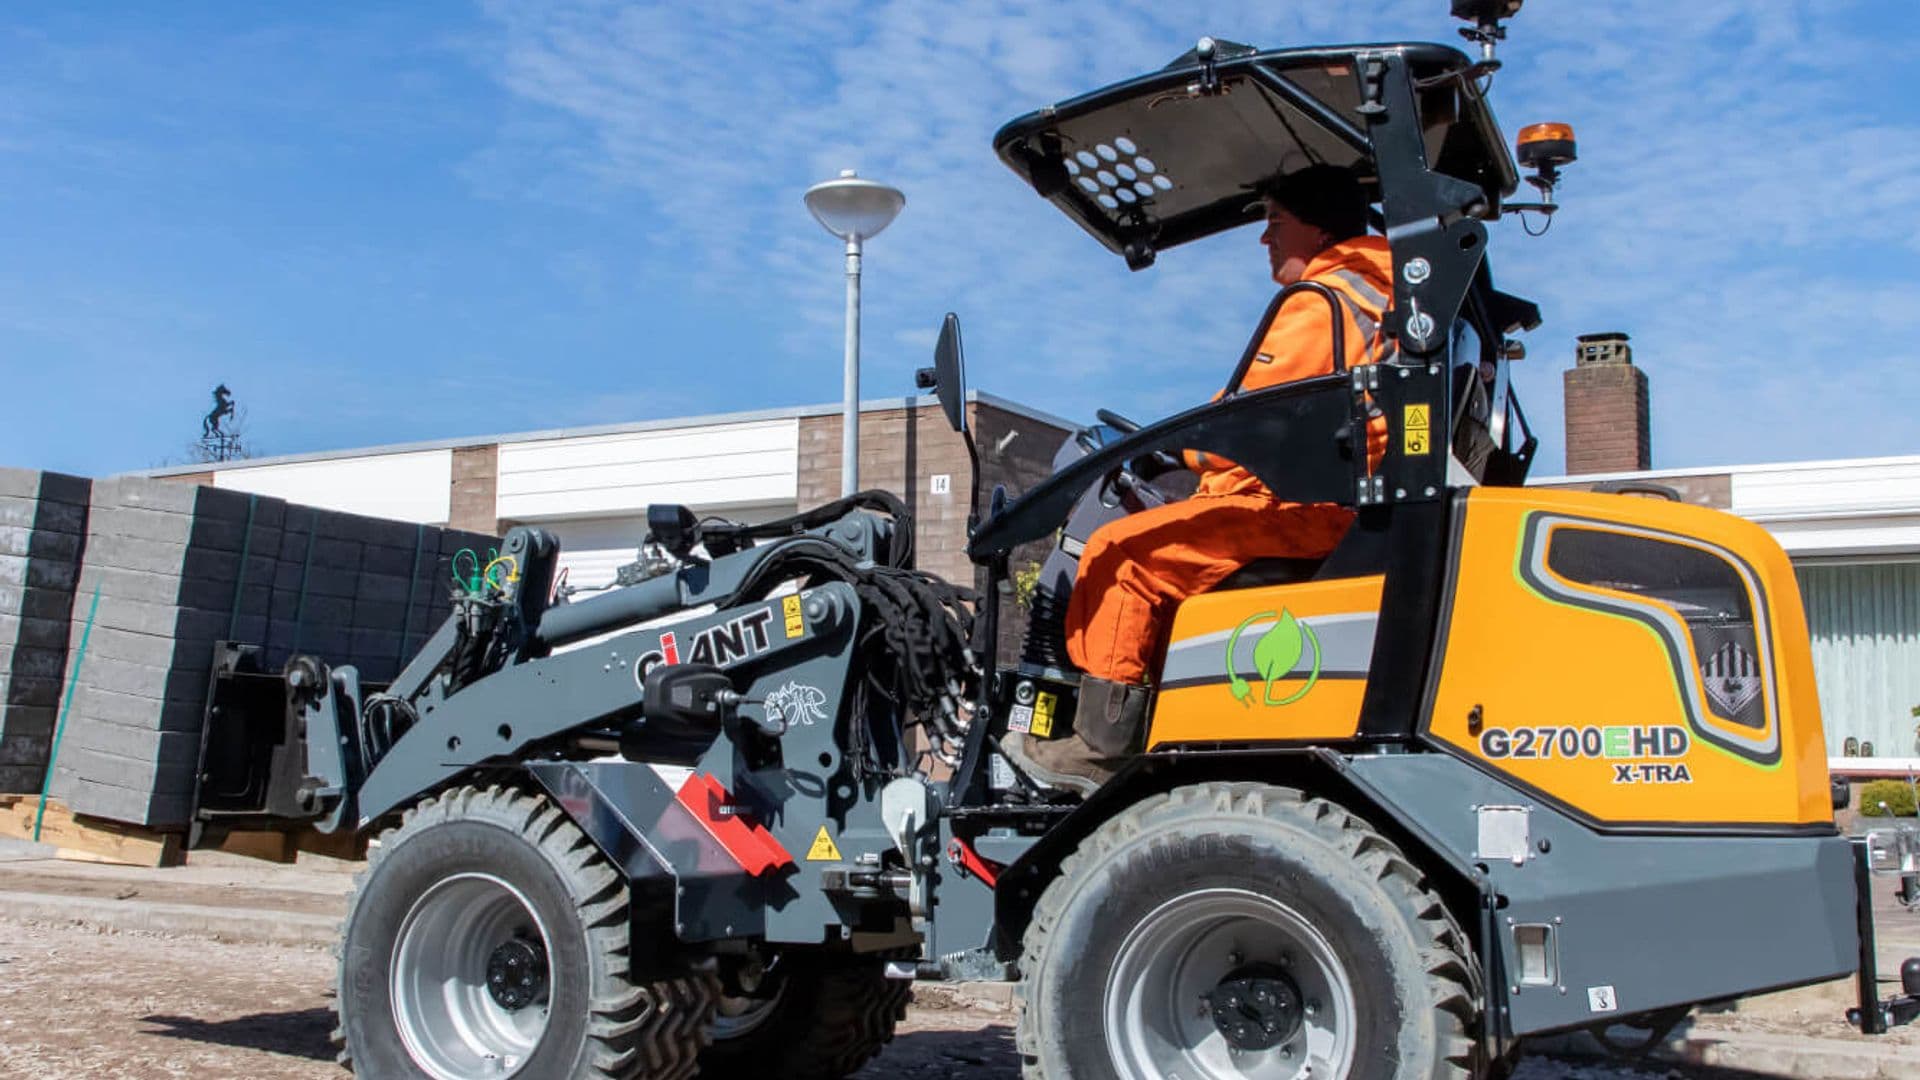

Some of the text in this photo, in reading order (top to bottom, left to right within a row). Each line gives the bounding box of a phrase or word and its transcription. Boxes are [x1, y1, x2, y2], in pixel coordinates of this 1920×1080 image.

[936, 478, 946, 491] 14
[1481, 726, 1688, 758] G2700EHD
[1614, 764, 1692, 783] X-TRA
